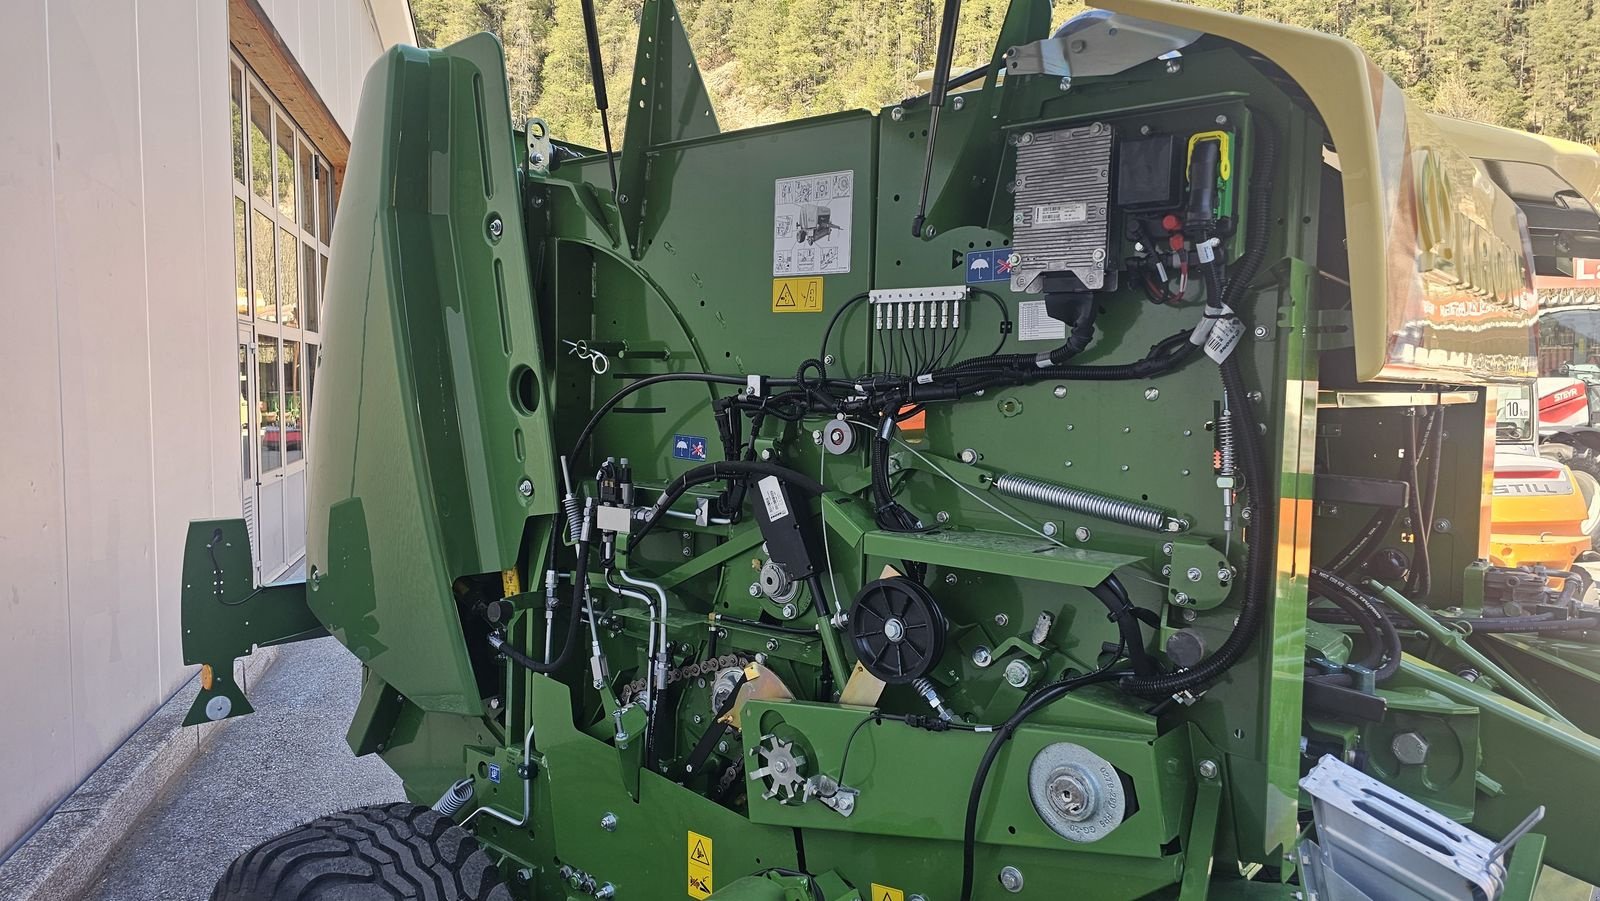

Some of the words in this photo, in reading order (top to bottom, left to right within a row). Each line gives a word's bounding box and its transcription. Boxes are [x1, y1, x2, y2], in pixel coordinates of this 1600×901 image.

[1553, 388, 1578, 402] STEYR
[1506, 402, 1519, 417] 10
[1520, 408, 1528, 417] km
[1494, 483, 1558, 495] STILL
